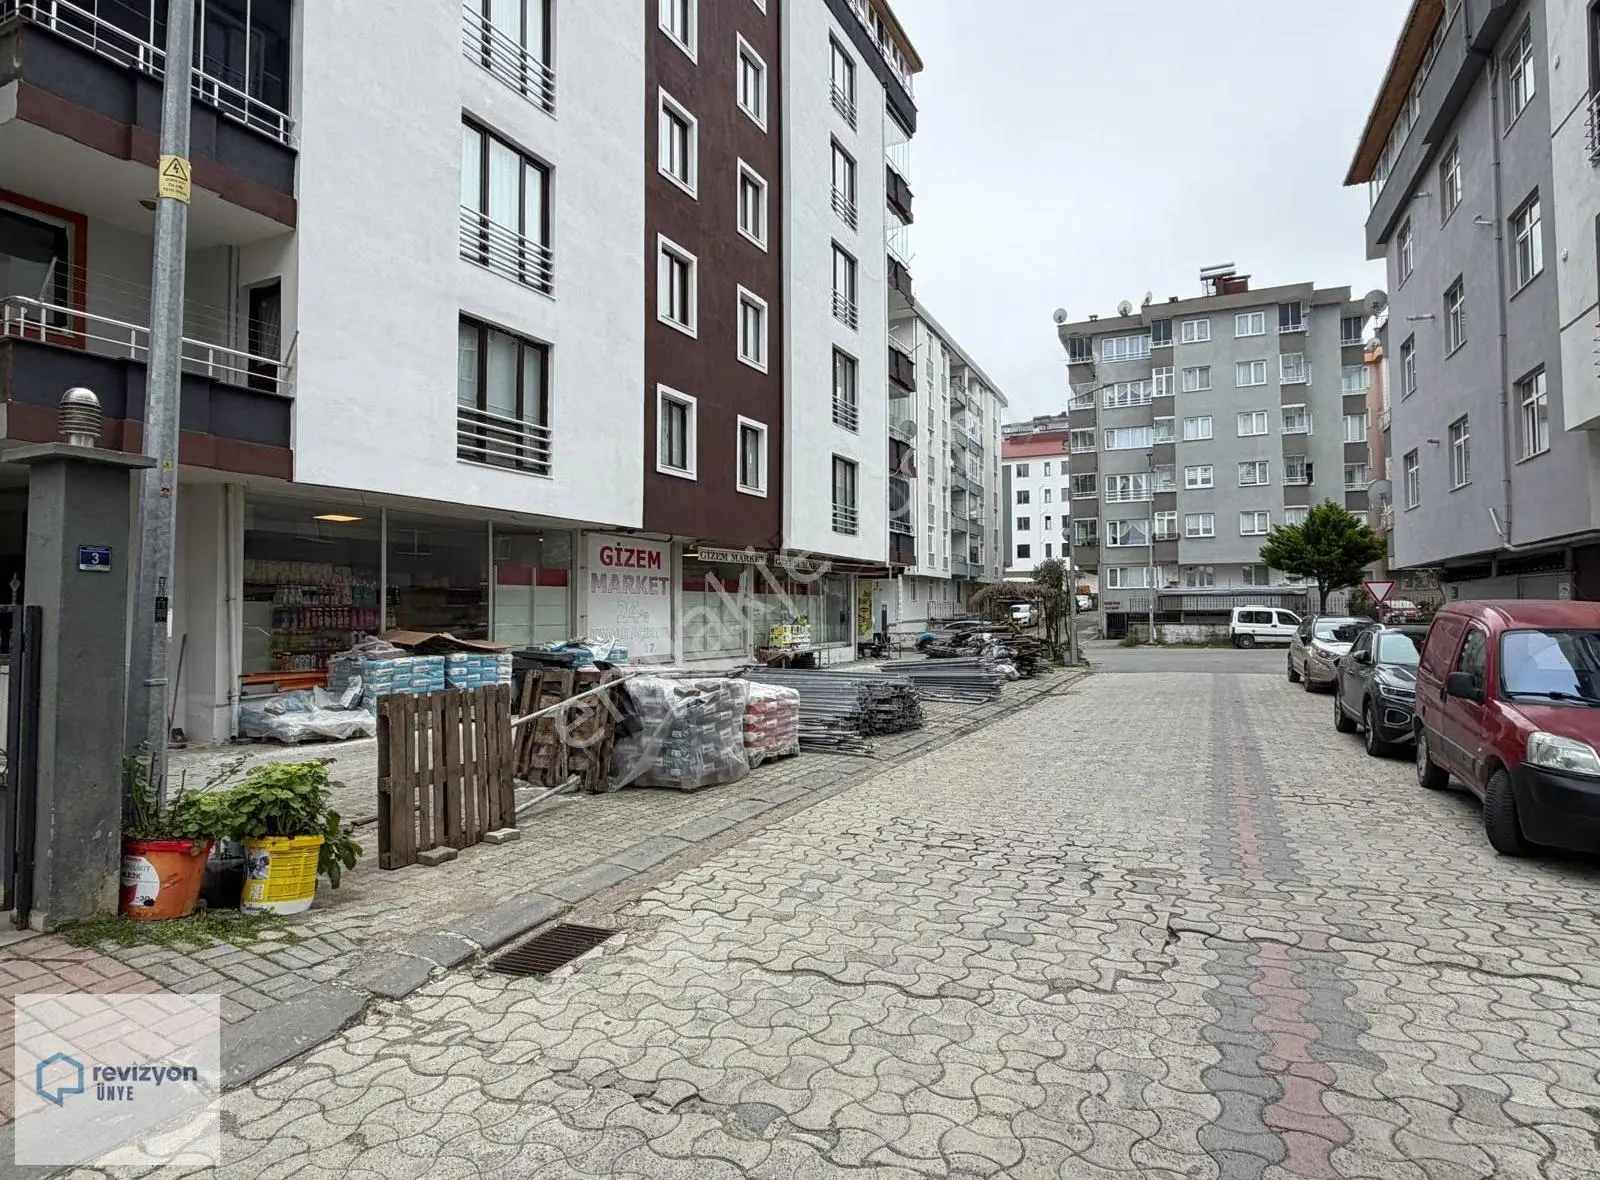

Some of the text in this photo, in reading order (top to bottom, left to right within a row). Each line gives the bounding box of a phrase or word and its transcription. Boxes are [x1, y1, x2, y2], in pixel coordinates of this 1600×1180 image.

[91, 552, 100, 564] 3
[600, 542, 661, 569] GİZEM
[591, 573, 669, 595] MARKET
